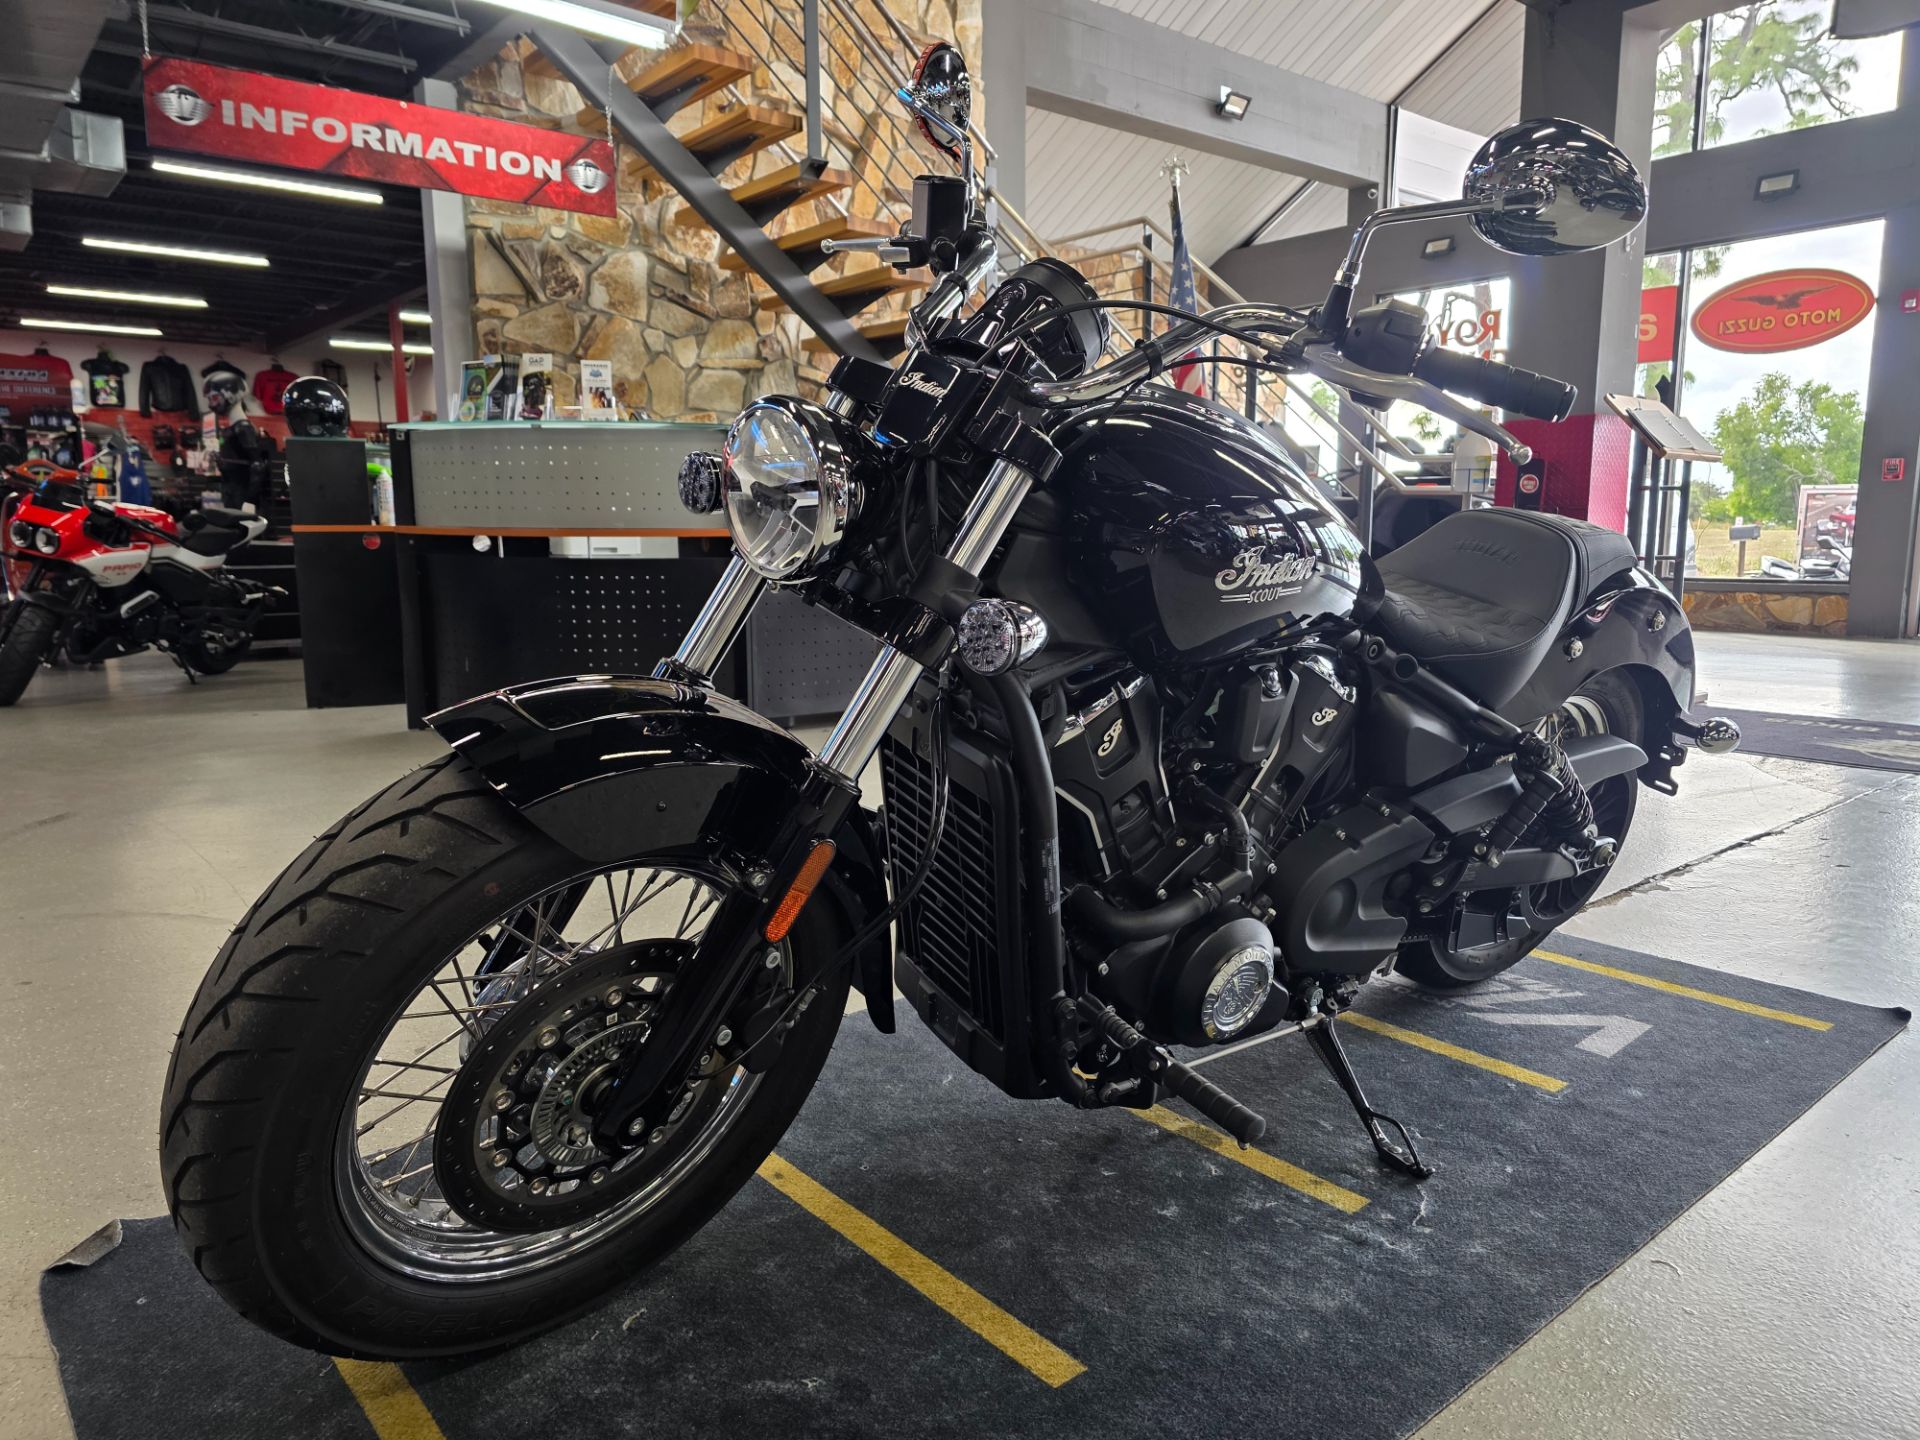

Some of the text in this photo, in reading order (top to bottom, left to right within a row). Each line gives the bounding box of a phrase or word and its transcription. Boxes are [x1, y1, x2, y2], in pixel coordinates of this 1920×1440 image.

[221, 99, 563, 181] INFORMATION
[899, 372, 946, 397] Indian
[1215, 546, 1316, 591] Indian
[1247, 587, 1282, 603] SCOUT
